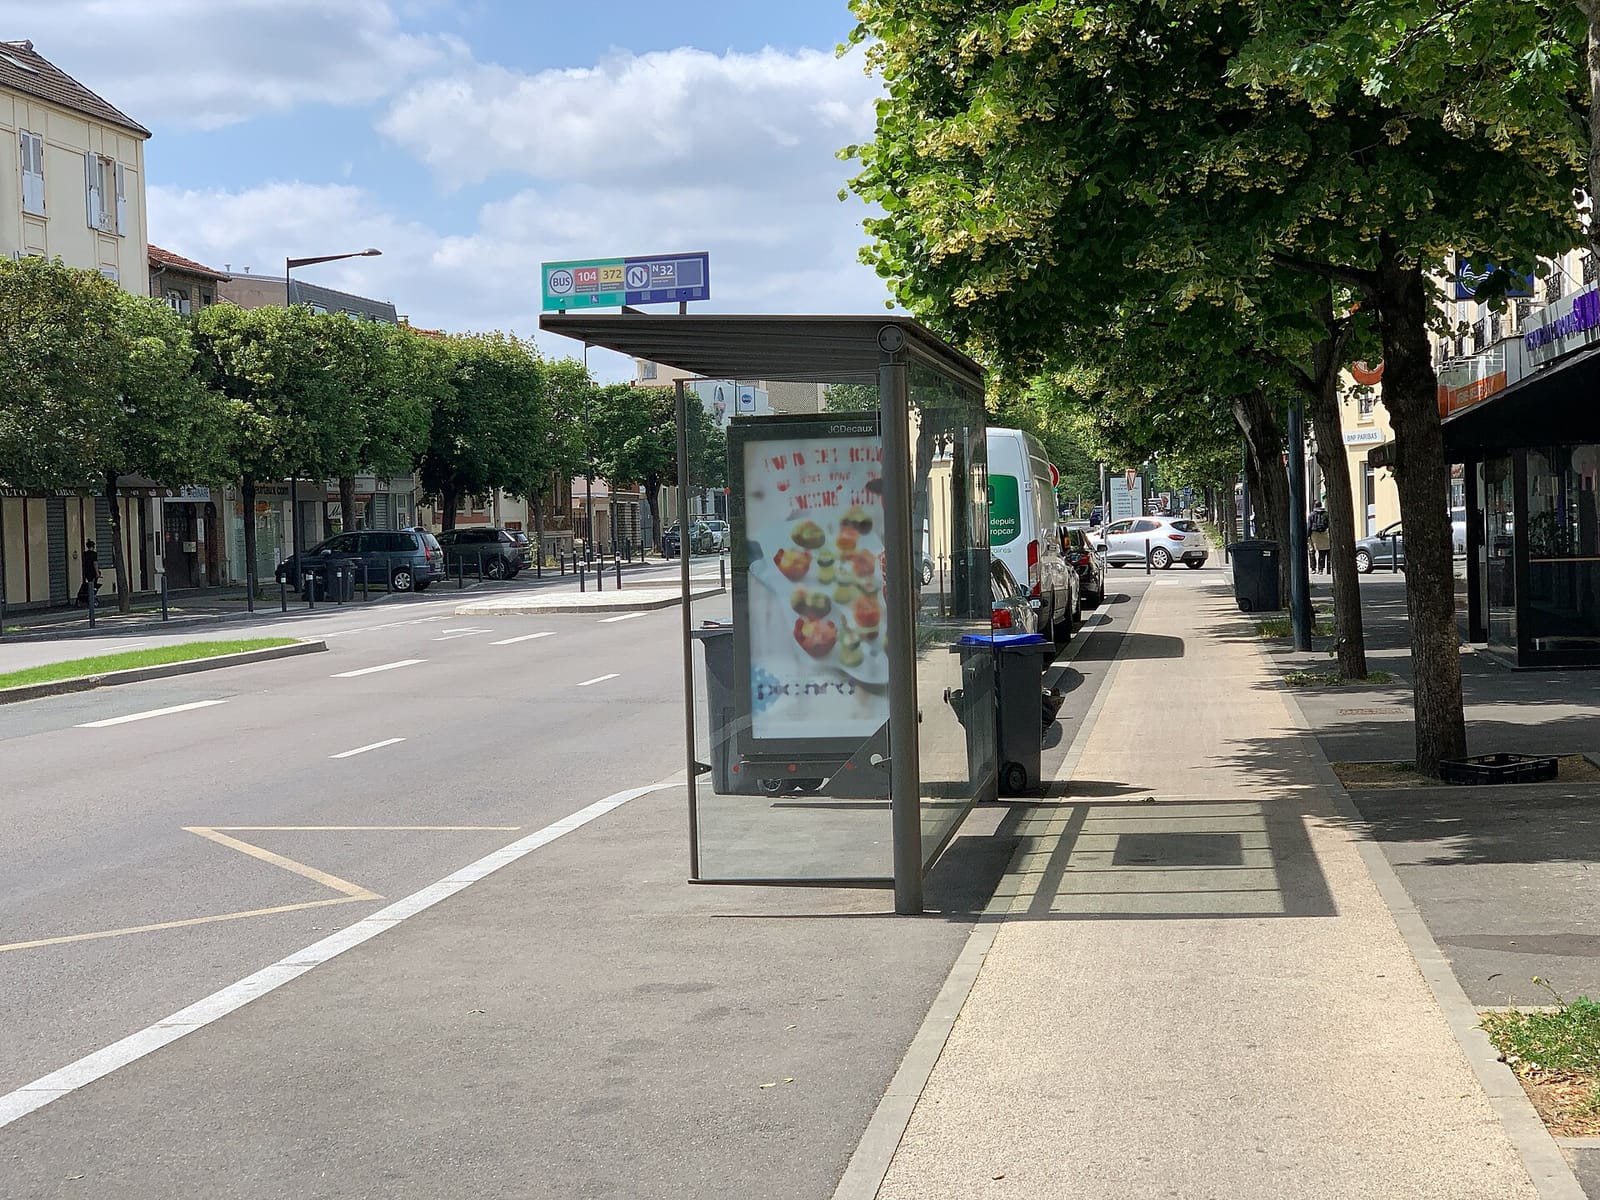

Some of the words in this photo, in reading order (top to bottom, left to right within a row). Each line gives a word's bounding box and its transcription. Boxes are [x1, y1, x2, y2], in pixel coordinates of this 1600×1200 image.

[552, 276, 571, 287] BUS
[577, 271, 597, 281] 104
[603, 269, 622, 280] 372
[631, 270, 644, 284] N
[828, 424, 873, 434] JCDecaux
[990, 518, 1015, 526] depuis
[990, 528, 1014, 536] ropcar
